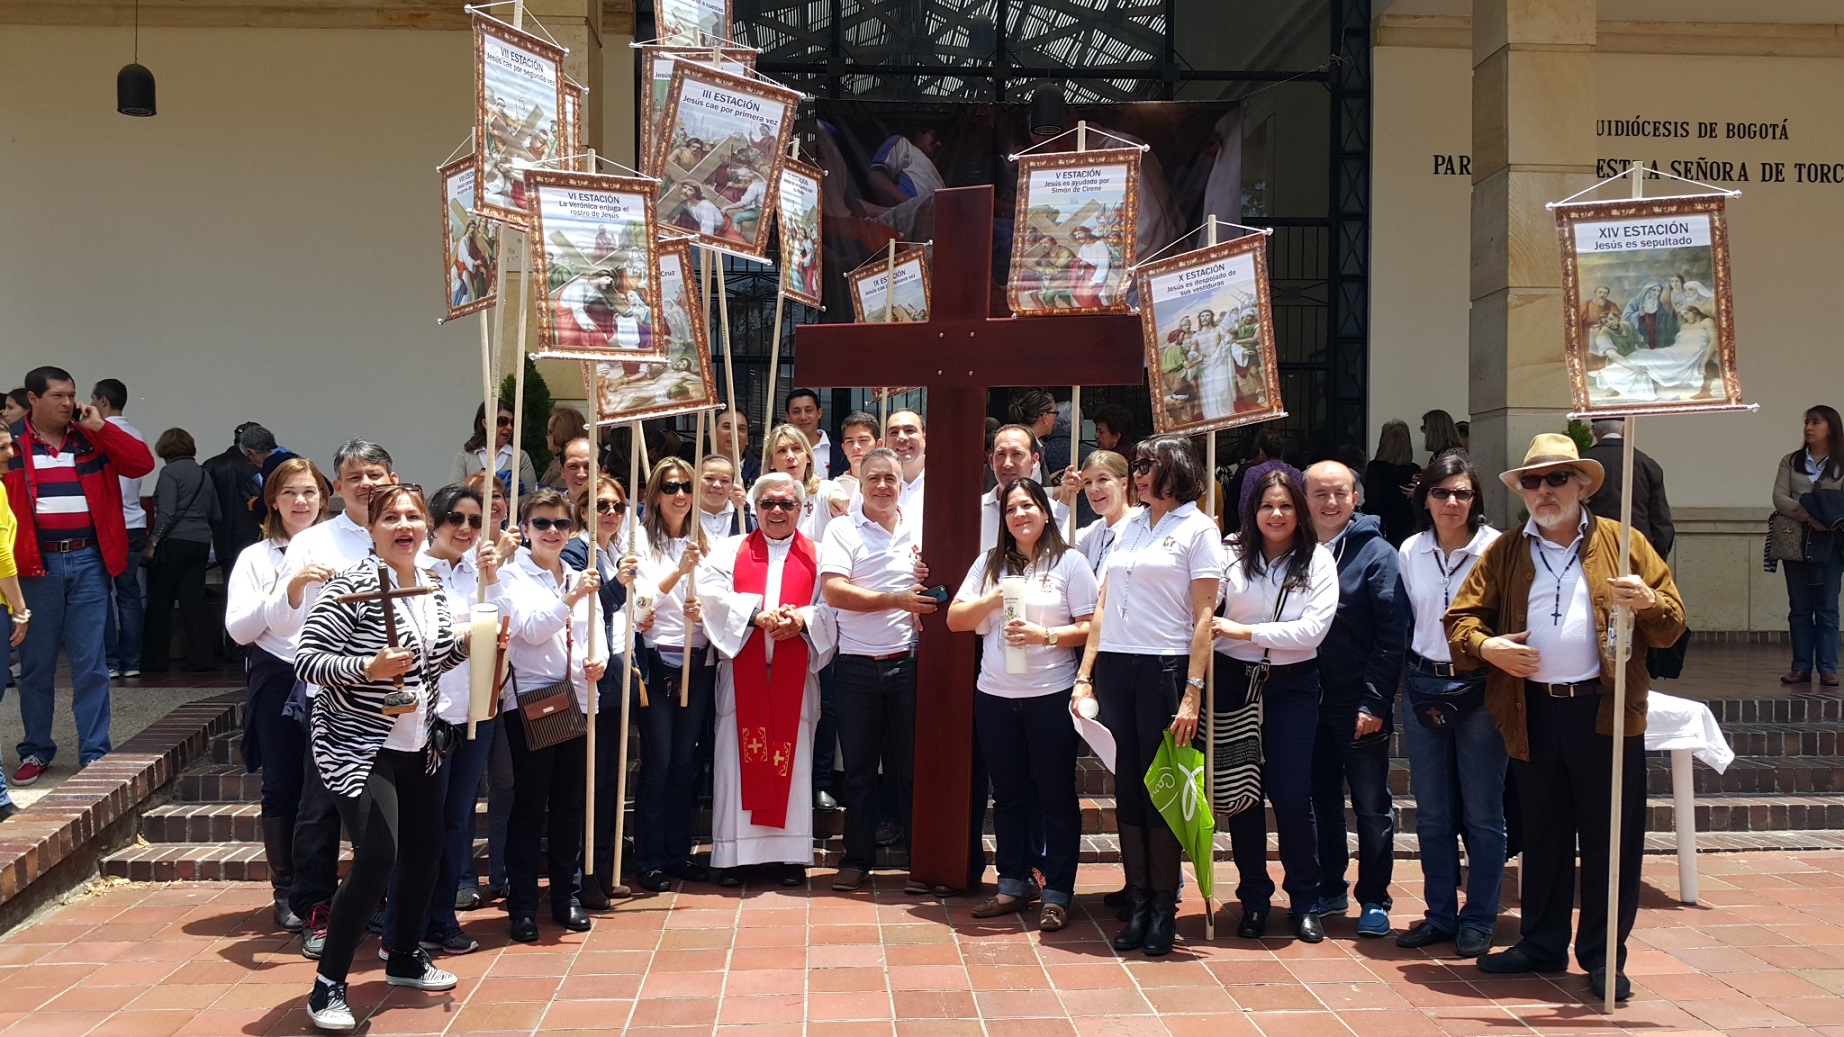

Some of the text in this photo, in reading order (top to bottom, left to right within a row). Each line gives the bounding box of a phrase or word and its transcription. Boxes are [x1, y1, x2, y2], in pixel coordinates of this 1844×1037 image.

[500, 47, 544, 72] VII ESTACIÓN
[486, 52, 556, 87] Jesús cae por segunda vez
[683, 95, 704, 106] Jesús
[705, 102, 720, 110] cae
[720, 105, 733, 114] por
[734, 109, 764, 122] primera
[702, 90, 760, 112] III ESTACIÓN
[1698, 122, 1718, 138] DE
[1726, 118, 1789, 140] BOGOTÁ
[1062, 168, 1101, 179] ESTACIÓN
[1670, 157, 1750, 182] SEÑORA
[1761, 162, 1785, 182] DE
[1071, 179, 1098, 188] ayudado
[568, 201, 597, 210] Verónica
[599, 204, 622, 213] enjuga
[579, 193, 620, 204] ESTACIÓN
[1598, 221, 1689, 238] XIV ESTACIÓN
[1594, 240, 1622, 250] Jesús
[1640, 236, 1692, 248] sepultado
[1186, 264, 1225, 280] ESTACIÓN
[1167, 283, 1184, 293] Jesús
[1194, 273, 1227, 286] despojado
[1193, 280, 1224, 293] vestiduras
